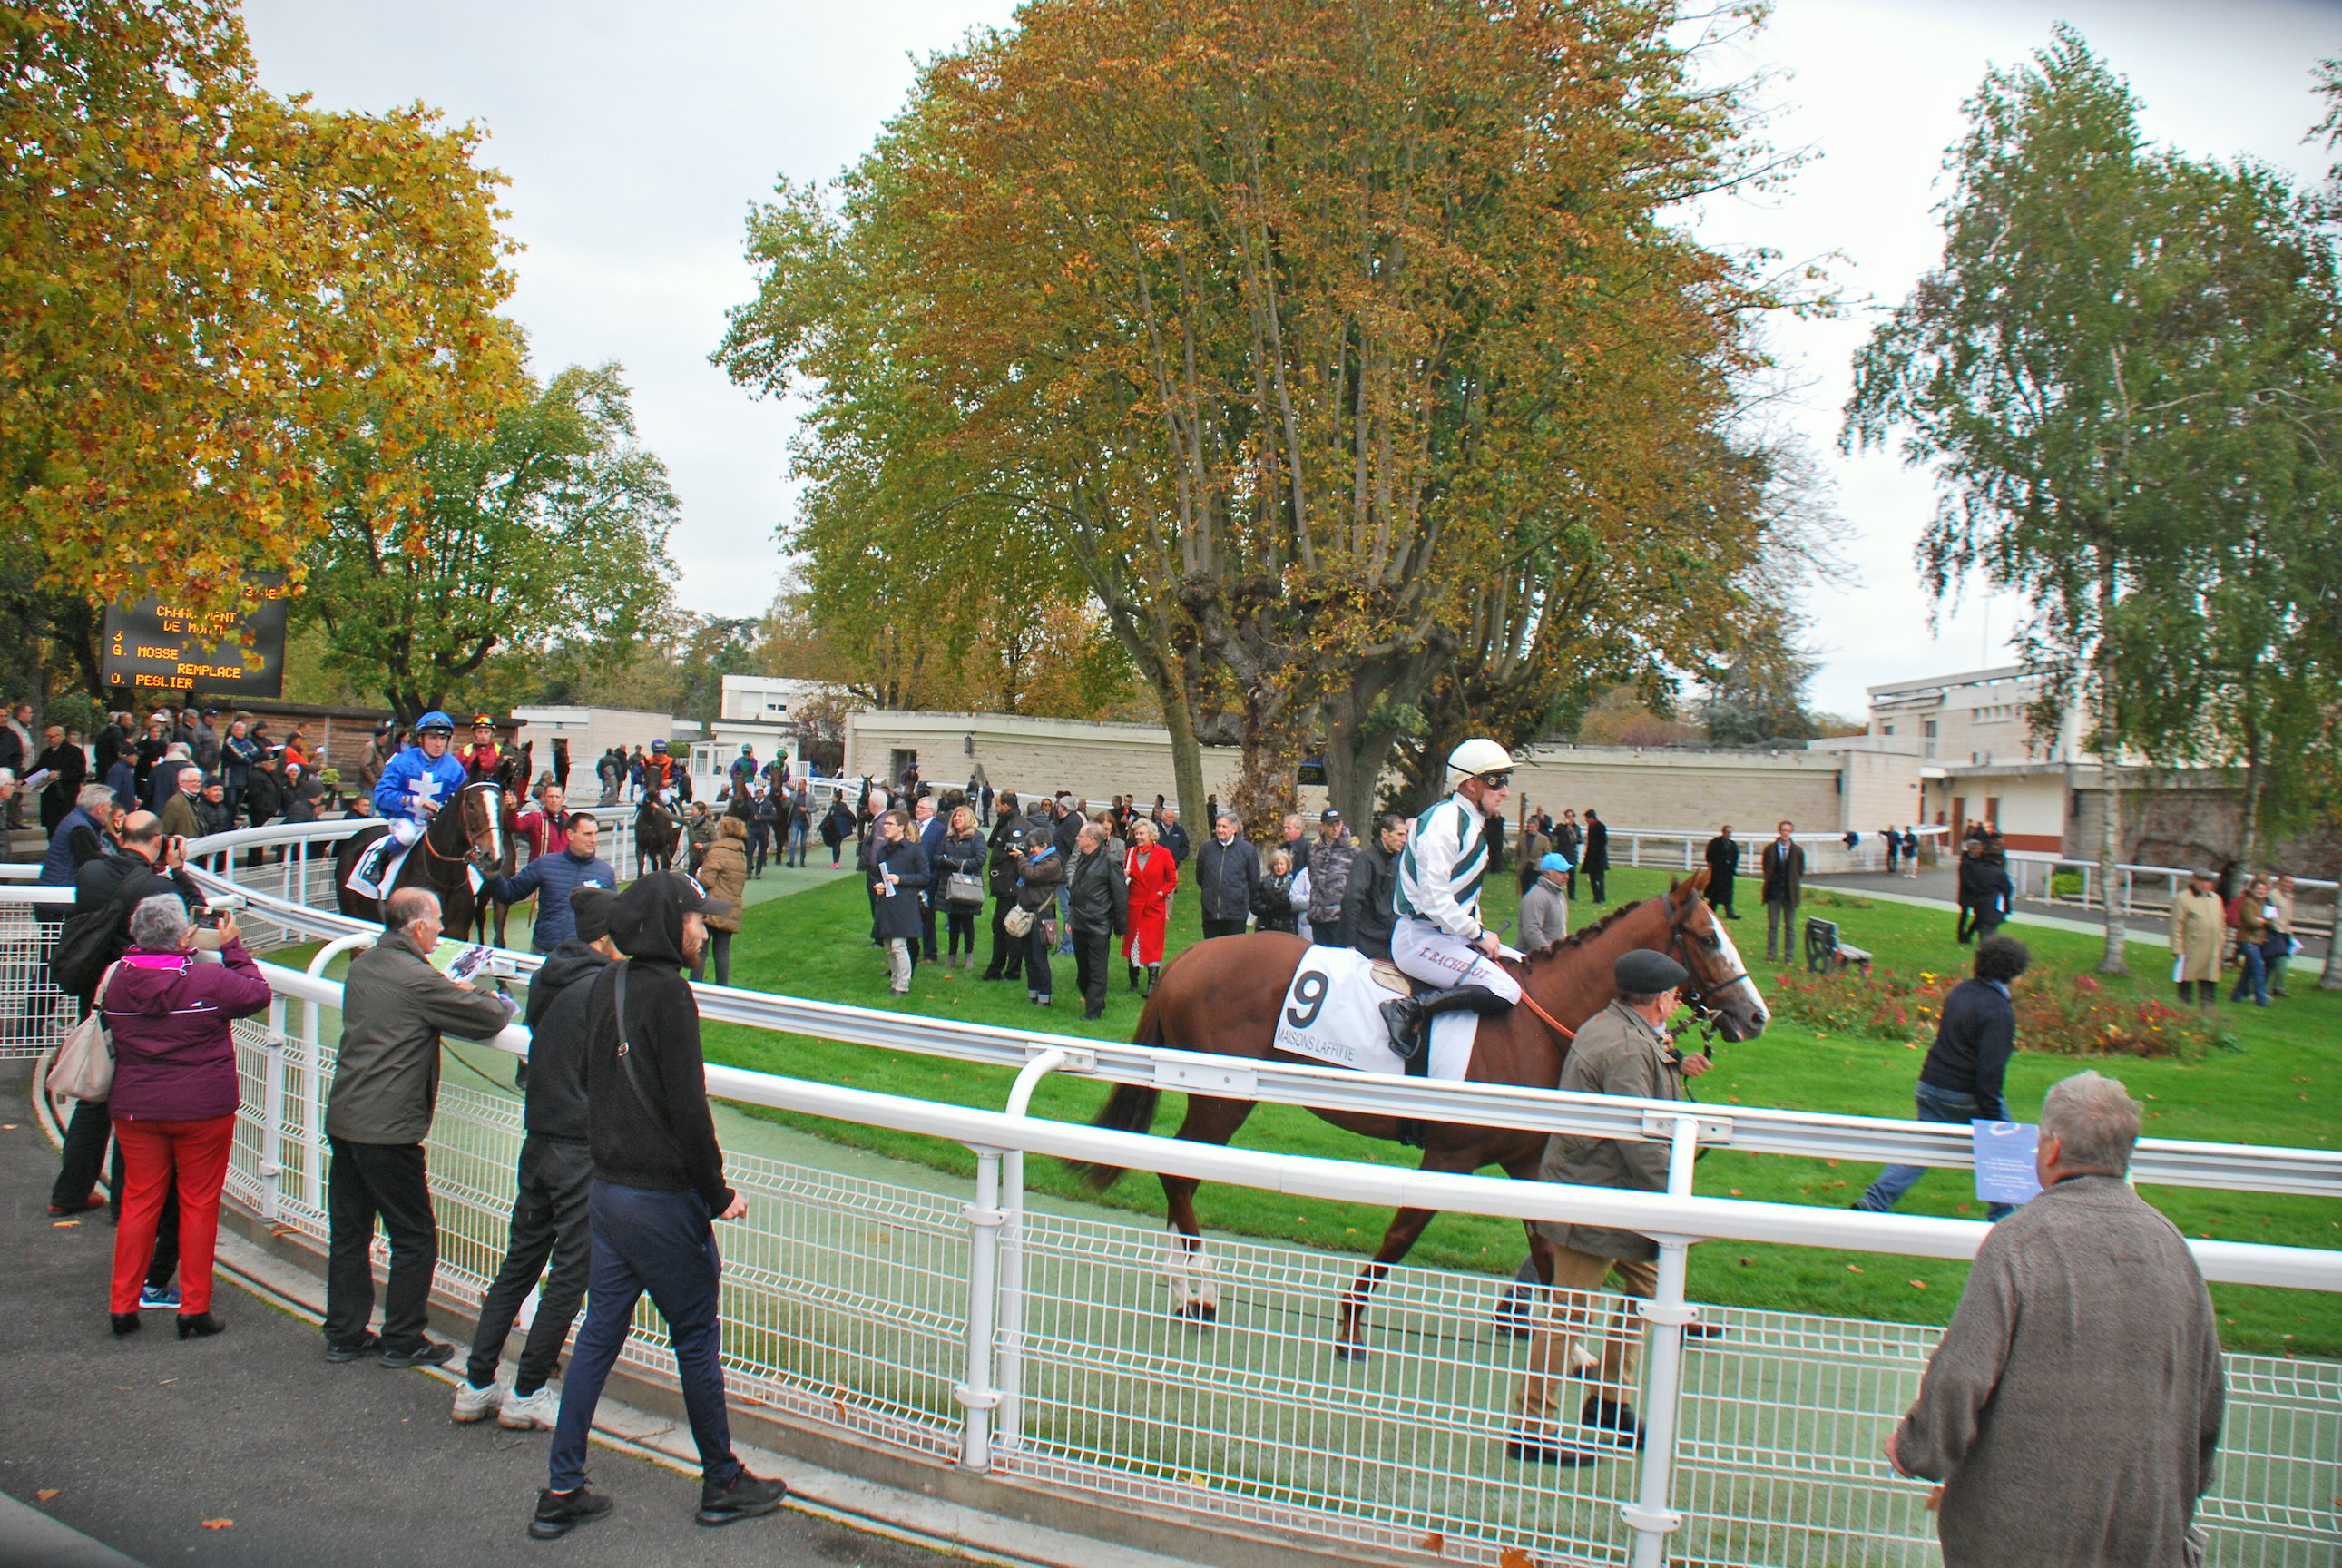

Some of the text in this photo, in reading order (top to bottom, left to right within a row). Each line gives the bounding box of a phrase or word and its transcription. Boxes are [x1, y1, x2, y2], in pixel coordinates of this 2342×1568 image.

[163, 620, 181, 632] DE
[113, 644, 179, 660] G. MOSSE
[177, 663, 241, 679] REMPLACE
[135, 674, 194, 689] PESLIER
[1428, 951, 1492, 979] BACHEOT
[1287, 970, 1328, 1029] 9
[1277, 1028, 1357, 1062] MAISONS LAFFITTE
